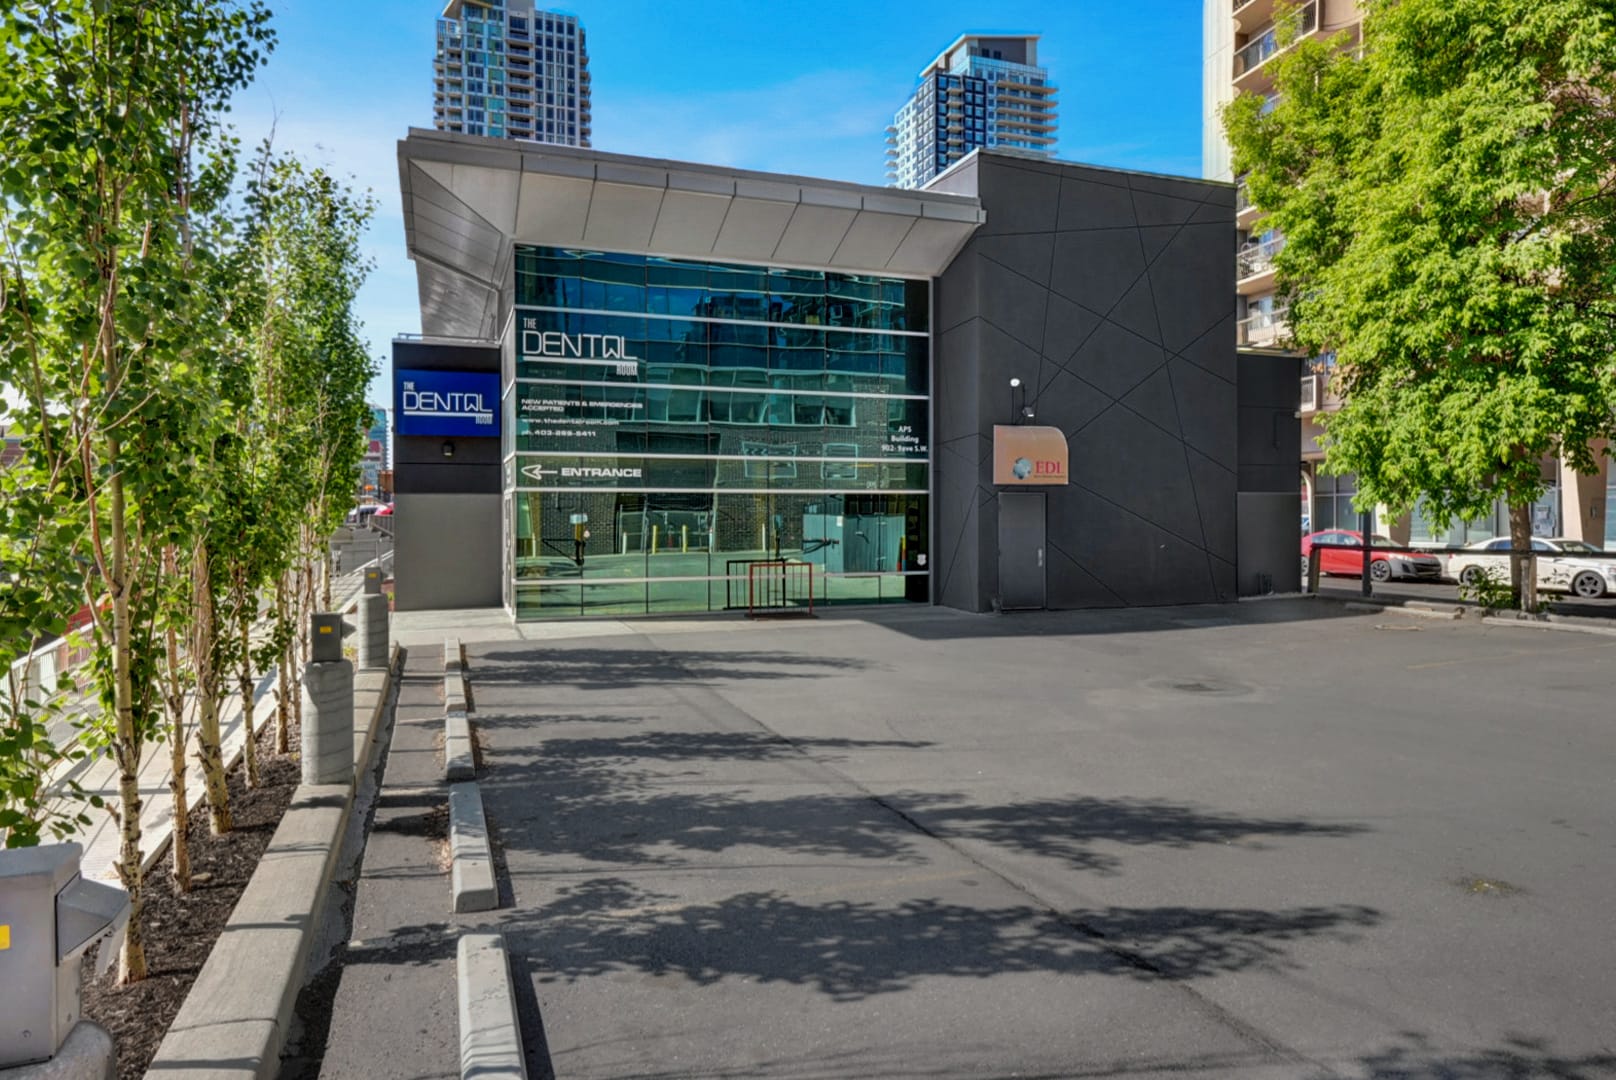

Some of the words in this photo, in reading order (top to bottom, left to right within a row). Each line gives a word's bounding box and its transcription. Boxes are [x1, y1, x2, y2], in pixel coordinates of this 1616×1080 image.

[523, 317, 537, 329] THE
[522, 330, 638, 360] DENTAL
[403, 381, 415, 391] THE
[403, 391, 493, 412] DENTAL
[521, 398, 541, 406] NEW
[542, 399, 580, 407] PATIENTS
[897, 425, 912, 433] APS
[890, 435, 919, 444] Building
[561, 467, 642, 477] ENTRANCE
[1035, 460, 1061, 474] EDI
